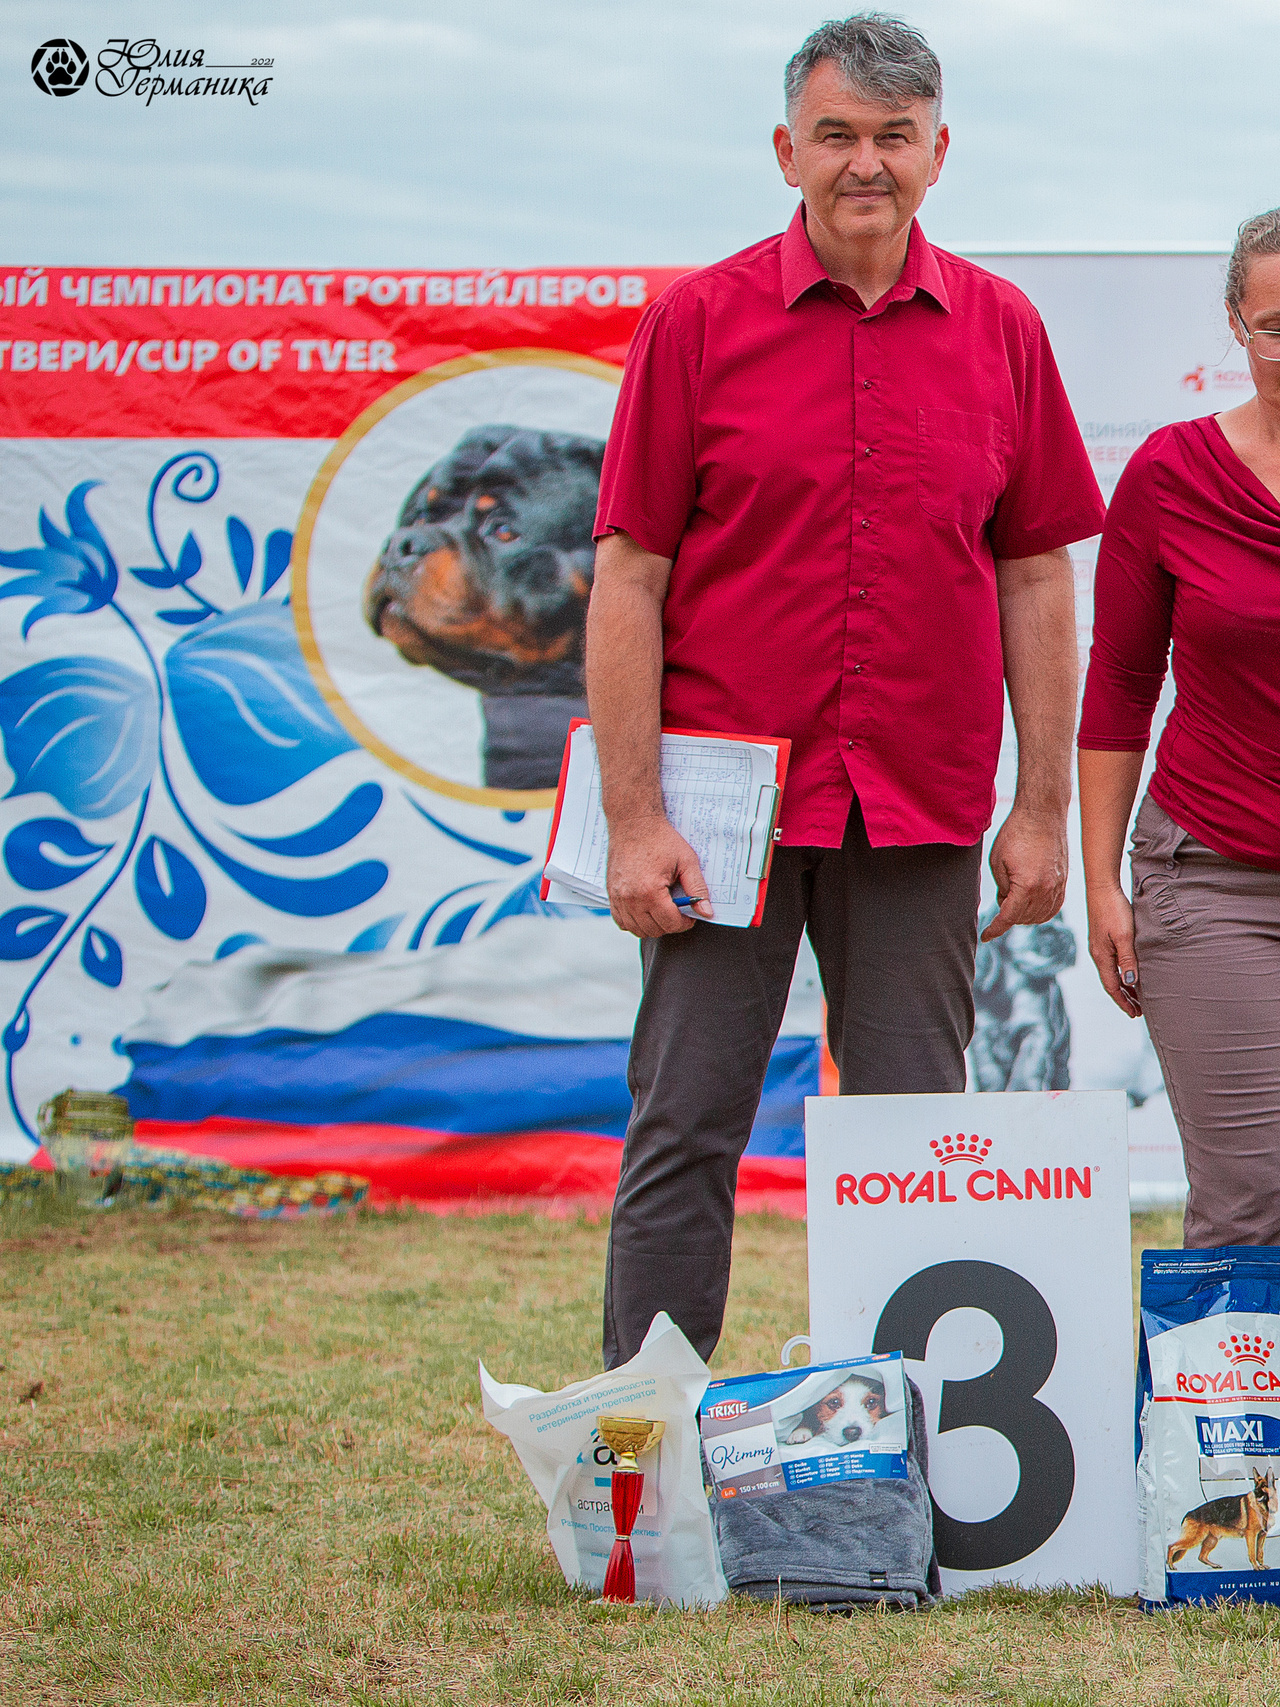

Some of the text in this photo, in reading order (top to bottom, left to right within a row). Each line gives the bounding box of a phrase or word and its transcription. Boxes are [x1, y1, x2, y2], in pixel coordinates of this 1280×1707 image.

[60, 274, 334, 306] ЧЕМПИОНАТ
[343, 269, 647, 307] РОТВЕЙЛЕРОВ
[227, 339, 283, 372] OF
[290, 339, 398, 372] TVER
[836, 1166, 1092, 1206] ROYAL CANIN
[1176, 1370, 1248, 1393] ROYAL
[529, 1378, 656, 1423] Разработка и производство
[536, 1389, 657, 1433] ветеринарных препаратов
[708, 1402, 748, 1419] TRIXIE
[872, 1259, 1075, 1571] 3
[1201, 1420, 1263, 1442] MAXI
[711, 1445, 775, 1470] Kimmy
[757, 1481, 768, 1490] 100
[769, 1480, 780, 1488] cm
[577, 1499, 644, 1514] астрам
